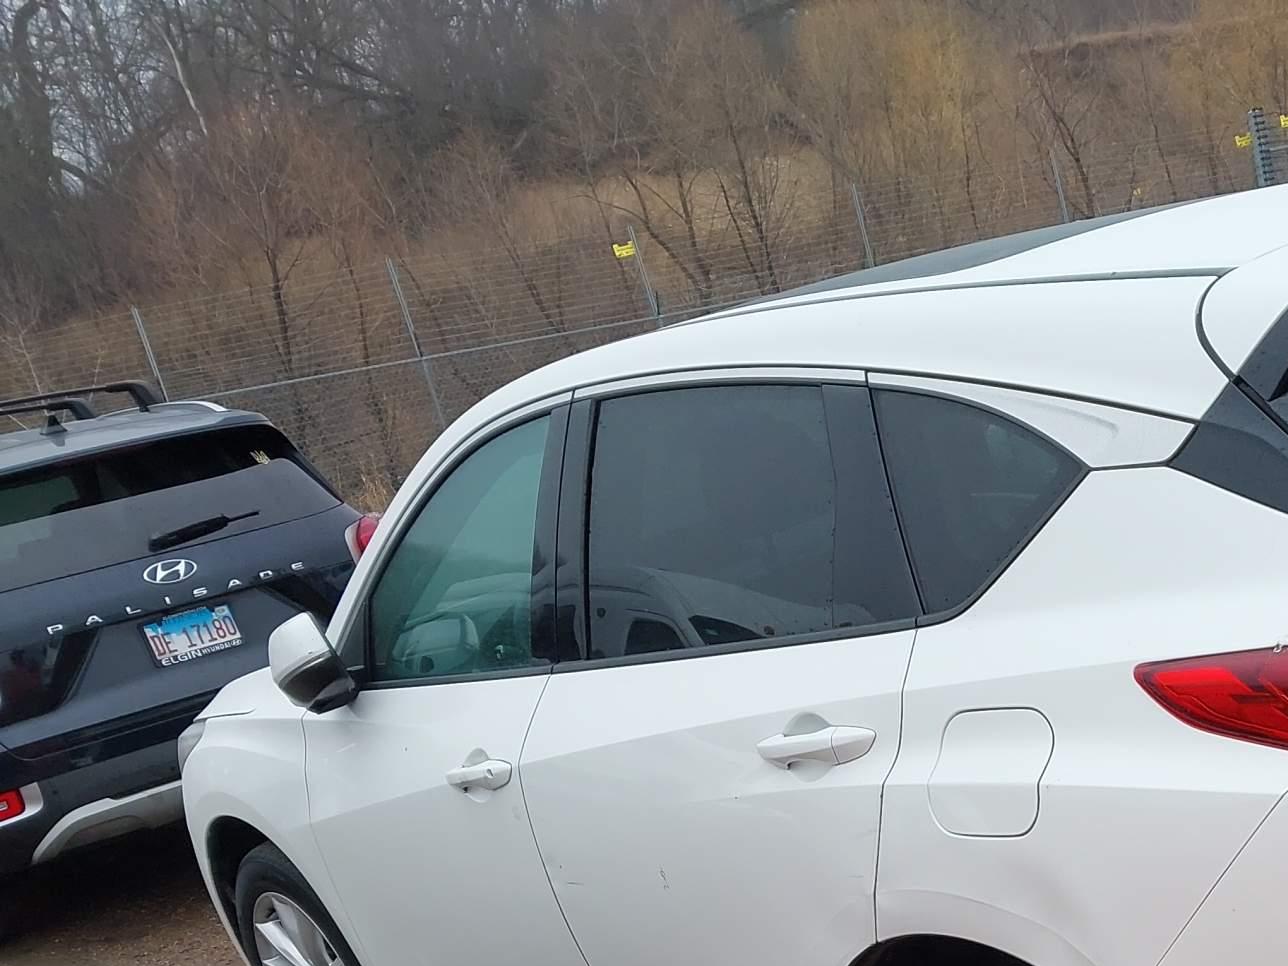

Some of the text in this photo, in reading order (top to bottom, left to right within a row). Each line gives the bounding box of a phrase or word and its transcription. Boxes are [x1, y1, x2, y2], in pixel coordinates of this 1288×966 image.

[47, 561, 305, 635] PALISADE
[150, 616, 237, 656] DE 17180
[161, 648, 203, 666] ELGIN
